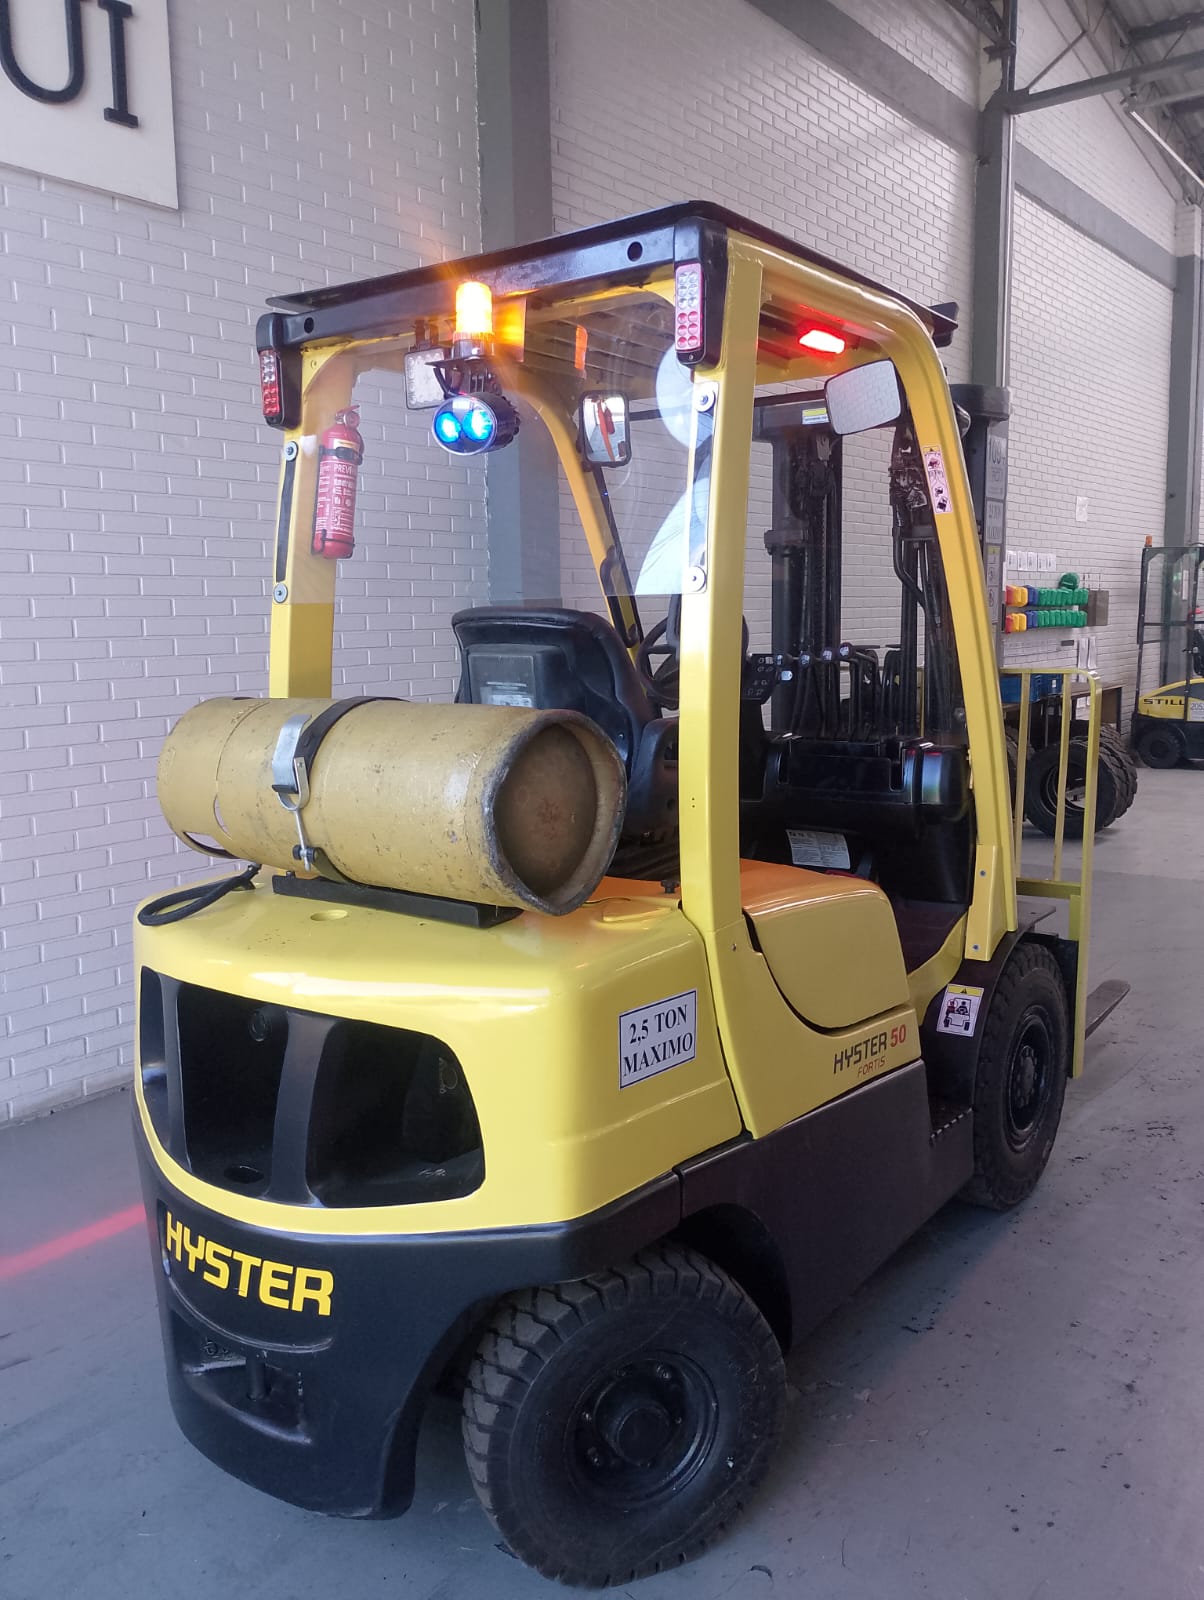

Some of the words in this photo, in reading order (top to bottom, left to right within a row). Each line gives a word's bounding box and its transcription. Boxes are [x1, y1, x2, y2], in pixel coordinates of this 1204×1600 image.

[1143, 698, 1185, 706] STILL
[654, 1004, 688, 1033] TON
[623, 1032, 694, 1077] MAXIMO
[833, 1032, 888, 1075] HYSTER
[890, 1023, 907, 1049] 50
[857, 1055, 887, 1079] FORTIS
[166, 1211, 334, 1316] HYSTER
